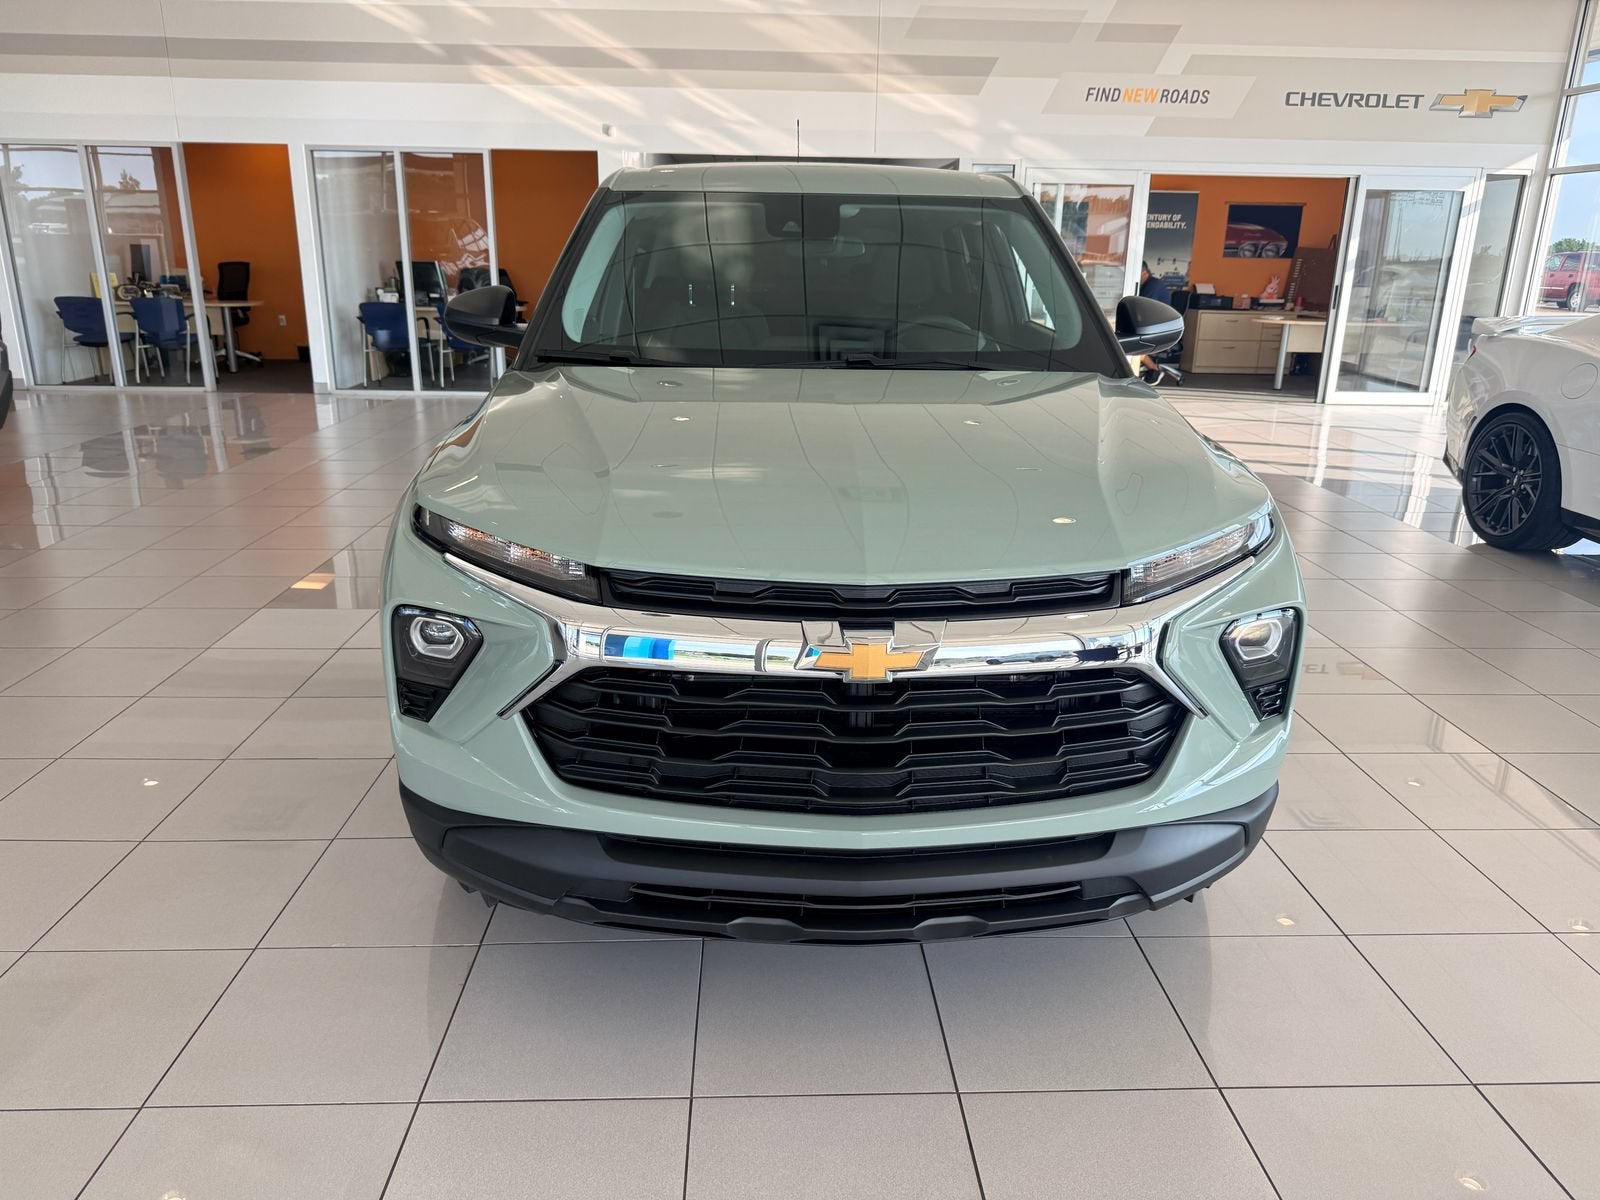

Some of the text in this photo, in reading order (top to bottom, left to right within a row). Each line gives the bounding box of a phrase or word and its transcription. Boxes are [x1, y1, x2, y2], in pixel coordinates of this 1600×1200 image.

[1085, 87, 1210, 104] FIND NEW ROADS
[1285, 91, 1425, 109] CHEVROLET
[1147, 213, 1182, 221] ENTURY OF
[1146, 221, 1187, 229] ENDABILITY.
